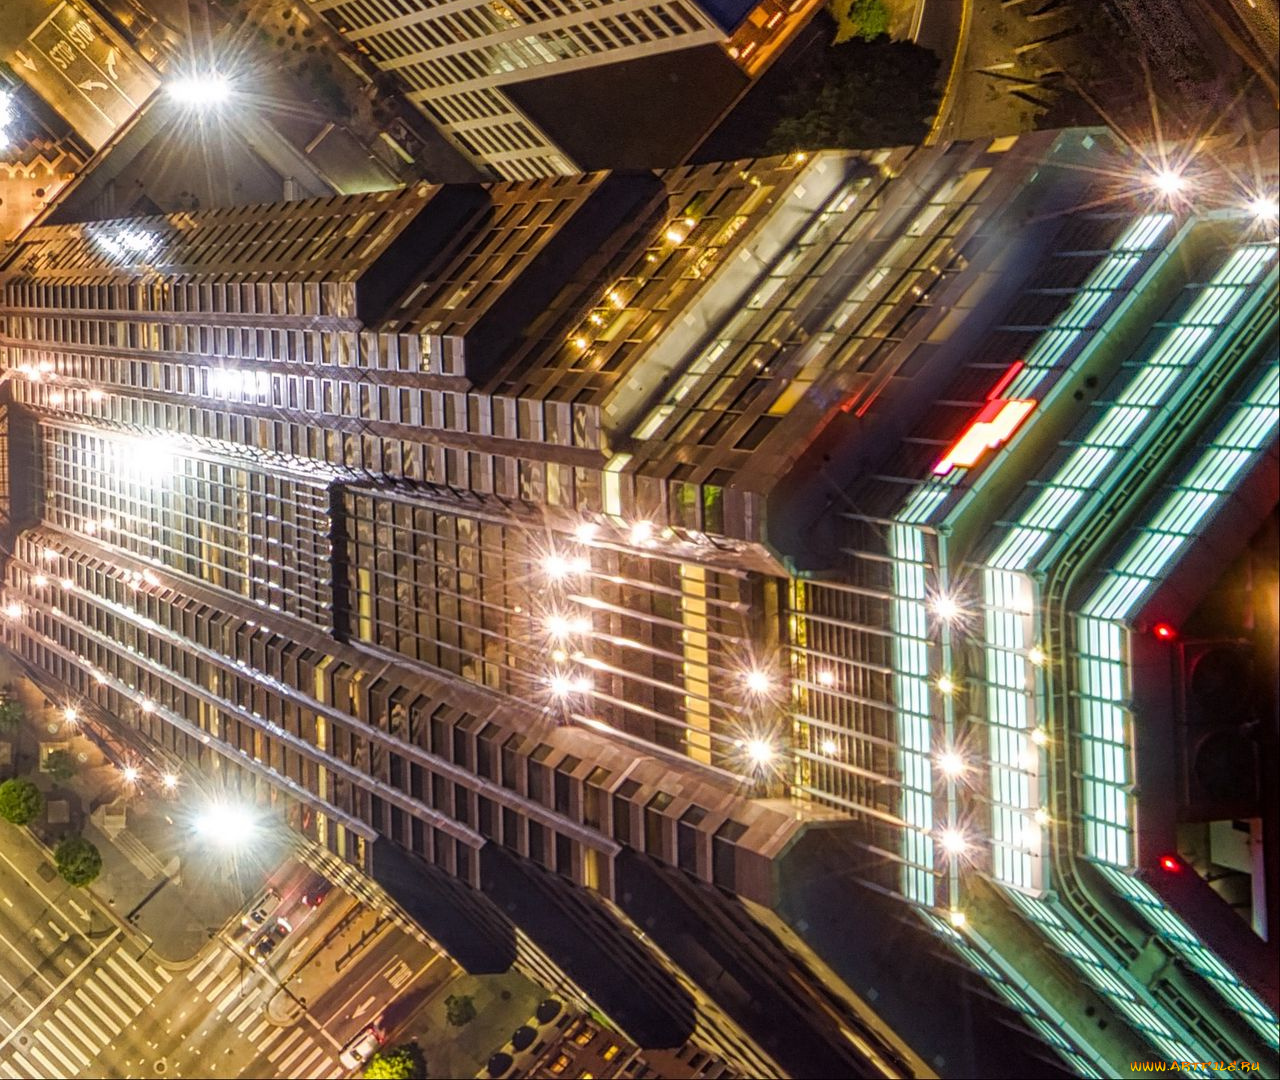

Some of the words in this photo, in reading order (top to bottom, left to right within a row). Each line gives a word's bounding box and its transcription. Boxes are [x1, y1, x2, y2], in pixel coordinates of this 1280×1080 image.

[68, 20, 96, 50] STOP
[49, 40, 77, 69] STOP
[383, 960, 413, 990] ONLY
